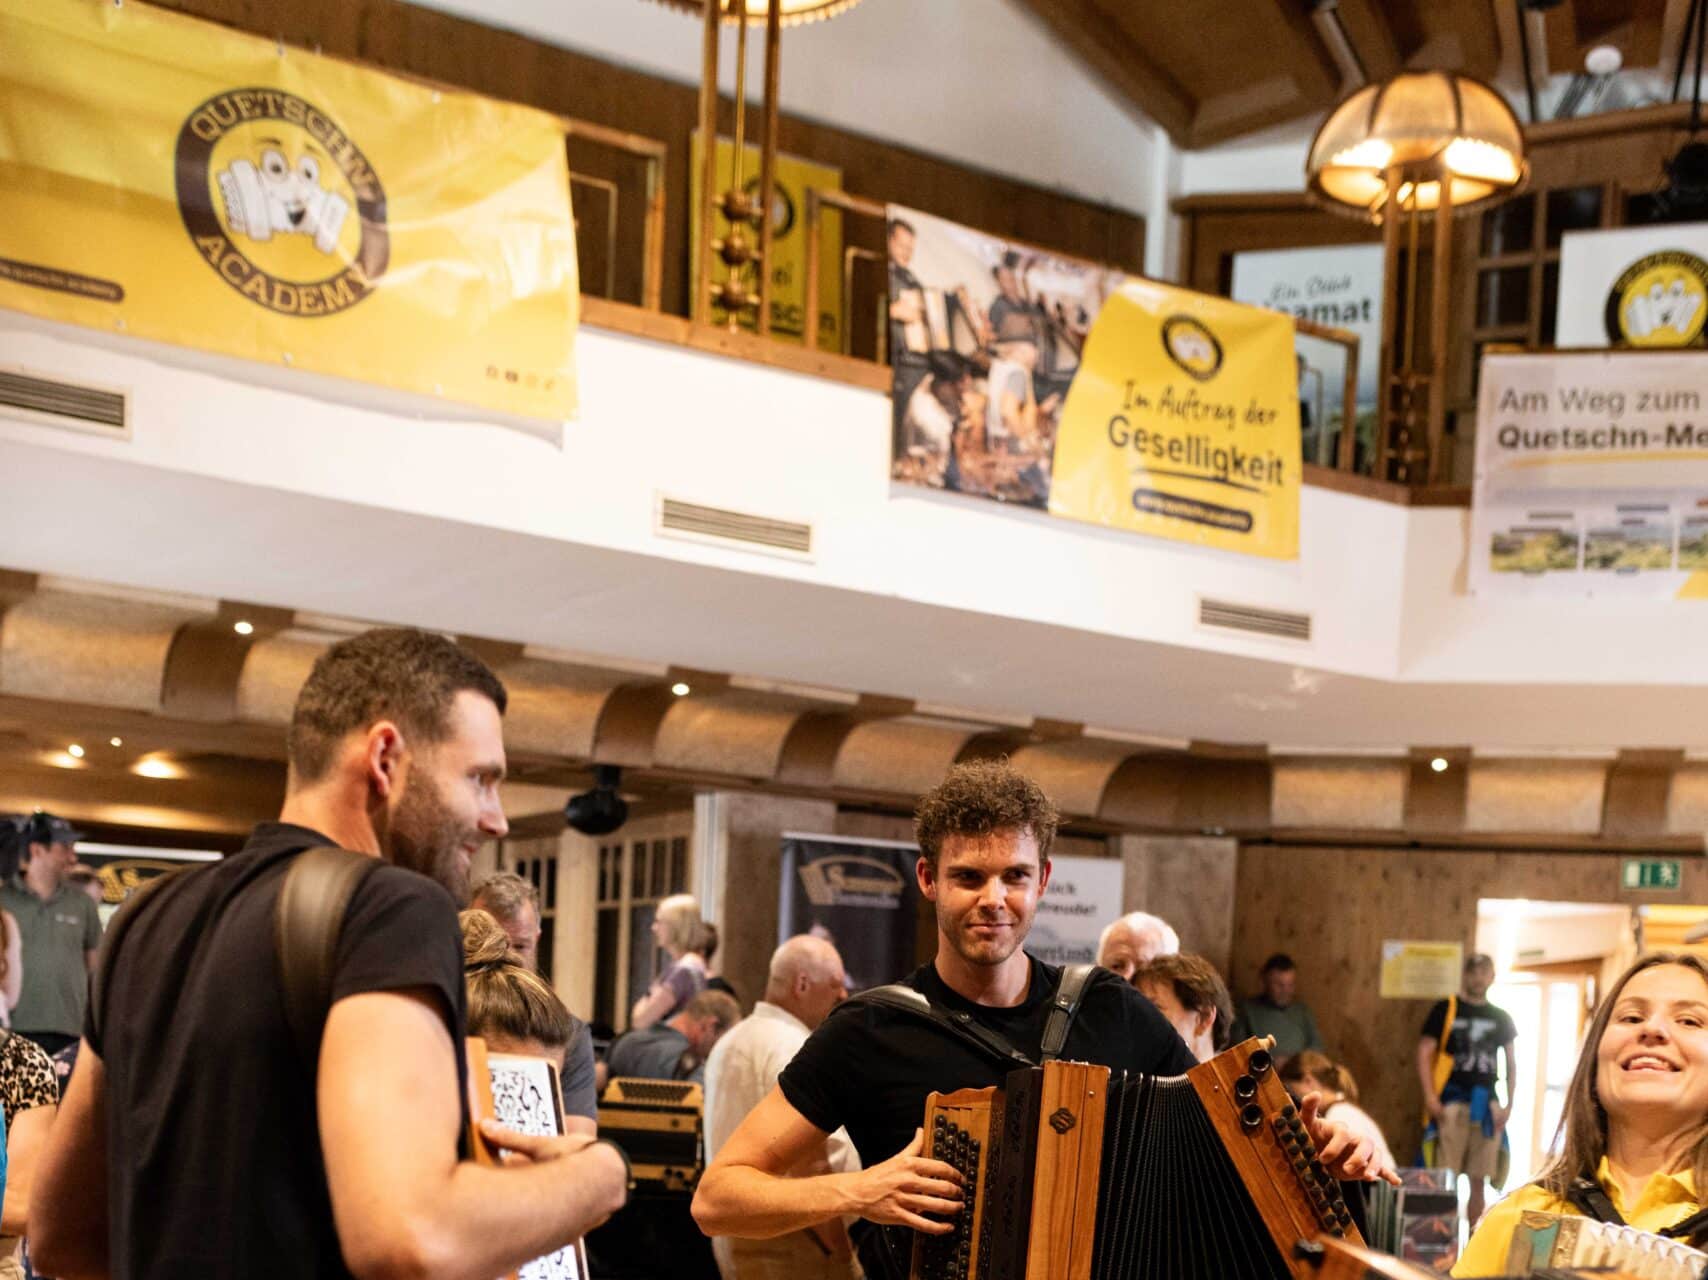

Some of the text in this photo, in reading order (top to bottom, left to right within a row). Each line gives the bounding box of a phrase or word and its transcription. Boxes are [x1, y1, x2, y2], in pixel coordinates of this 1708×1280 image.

[191, 91, 381, 202] QUETSCHN
[197, 236, 378, 314] ACADEMY
[1157, 385, 1236, 430] Auftrag
[1244, 399, 1278, 425] der
[1500, 388, 1700, 417] Am Weg zum
[1108, 414, 1284, 486] Geselligkeit
